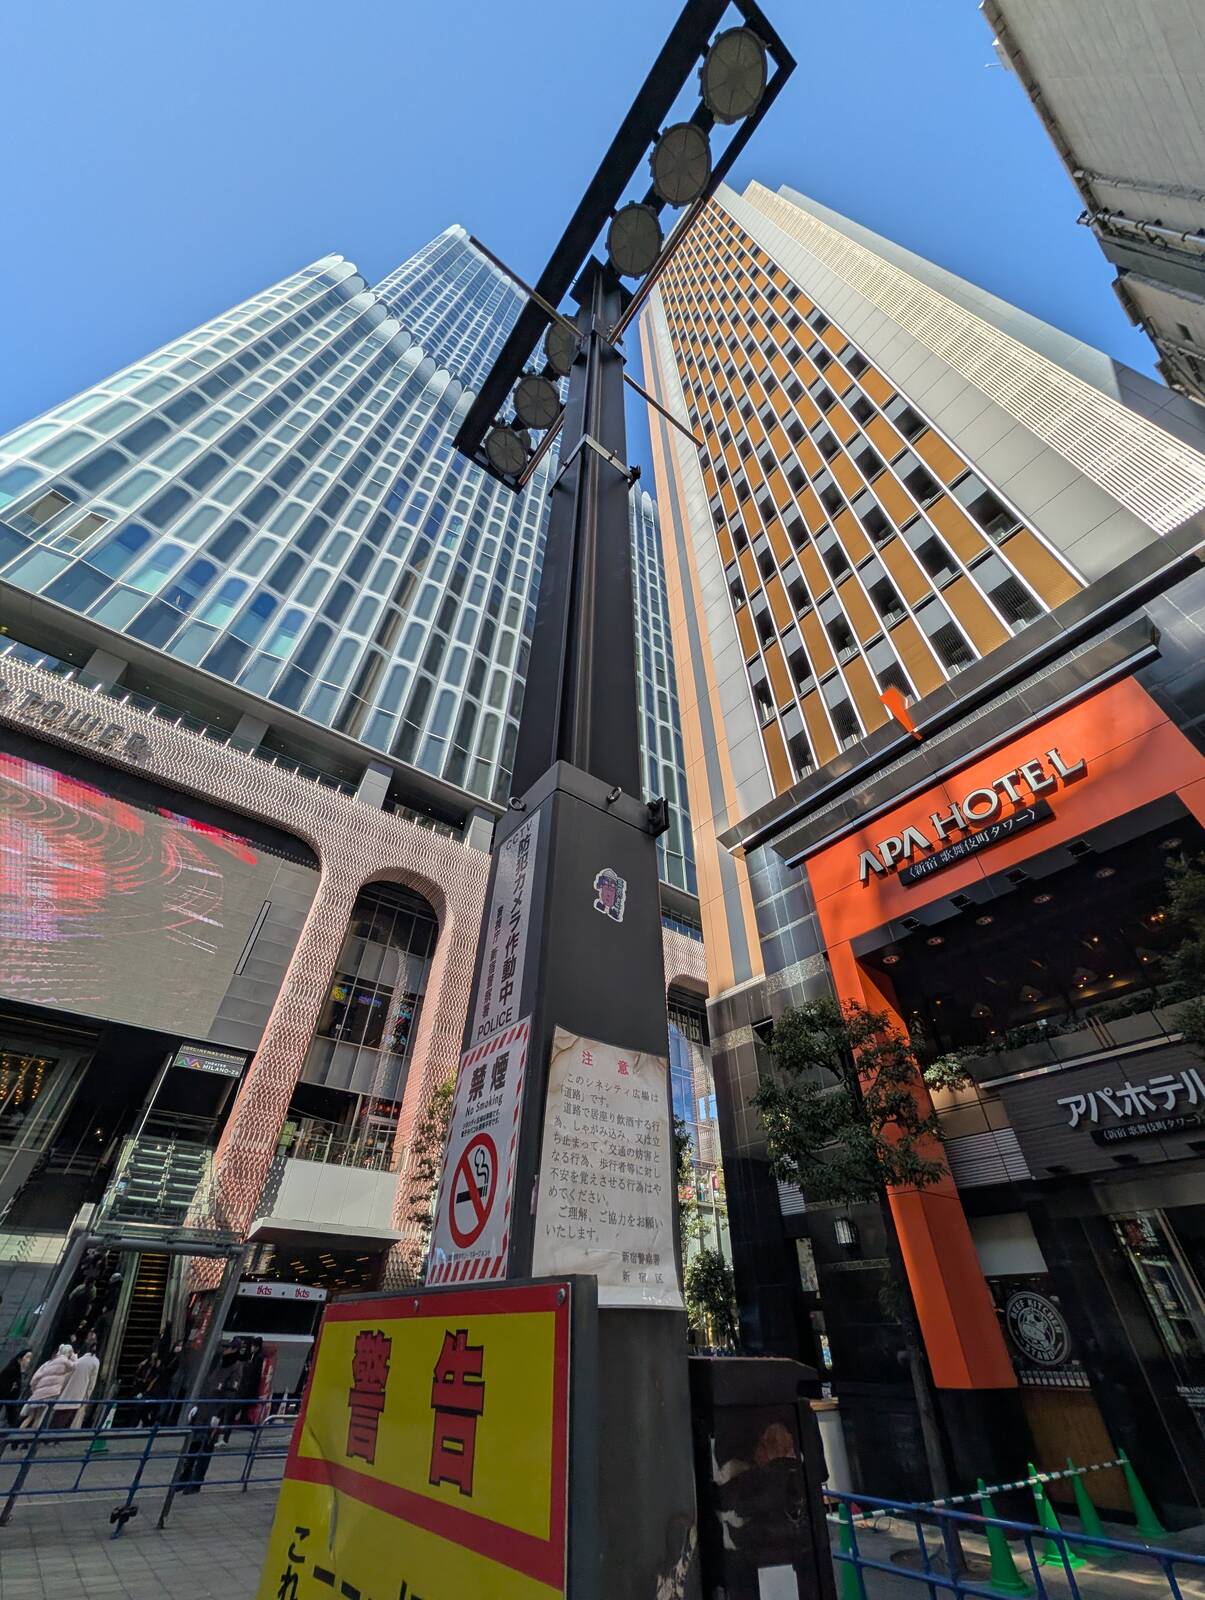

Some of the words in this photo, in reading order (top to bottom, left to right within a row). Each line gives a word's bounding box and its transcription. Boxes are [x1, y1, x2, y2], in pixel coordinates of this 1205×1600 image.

[17, 689, 149, 756] TOWER
[857, 825, 932, 885] APA
[929, 748, 1088, 841] HOTEL
[506, 819, 533, 850] CCTV
[499, 834, 532, 1007] 防犯カメラ作動中
[476, 1007, 513, 1041] POLICE
[581, 1047, 630, 1076] 注意
[467, 1050, 510, 1104] 禁煙
[567, 1073, 660, 1104] このシネシティ広場は
[465, 1104, 475, 1118] No
[475, 1093, 504, 1113] Smoking
[560, 1080, 610, 1109] 「道路」です。
[1056, 1068, 1205, 1128] アパホテル
[554, 1115, 661, 1147] 為、しゃがみ込み、又は立
[562, 1101, 660, 1133] 道路で居座り飲酒する行
[553, 1133, 661, 1163] ち止まって、交通の妨害と
[551, 1149, 660, 1179] なる行為、歩行者等に対し
[549, 1166, 662, 1196] 不安を覚えさせる行為はや
[548, 1185, 610, 1209] めてください。
[558, 1205, 664, 1230] ご理解、ご協力をお願い
[545, 1223, 600, 1243] いたします。
[622, 1251, 661, 1267] 新宿警察署
[256, 1285, 273, 1296] tkts
[294, 1288, 311, 1300] tkts
[1009, 1300, 1026, 1320] BEEF
[1027, 1299, 1063, 1334] KITCHEN
[1024, 1343, 1056, 1361] STAND
[345, 1328, 486, 1498] 警告
